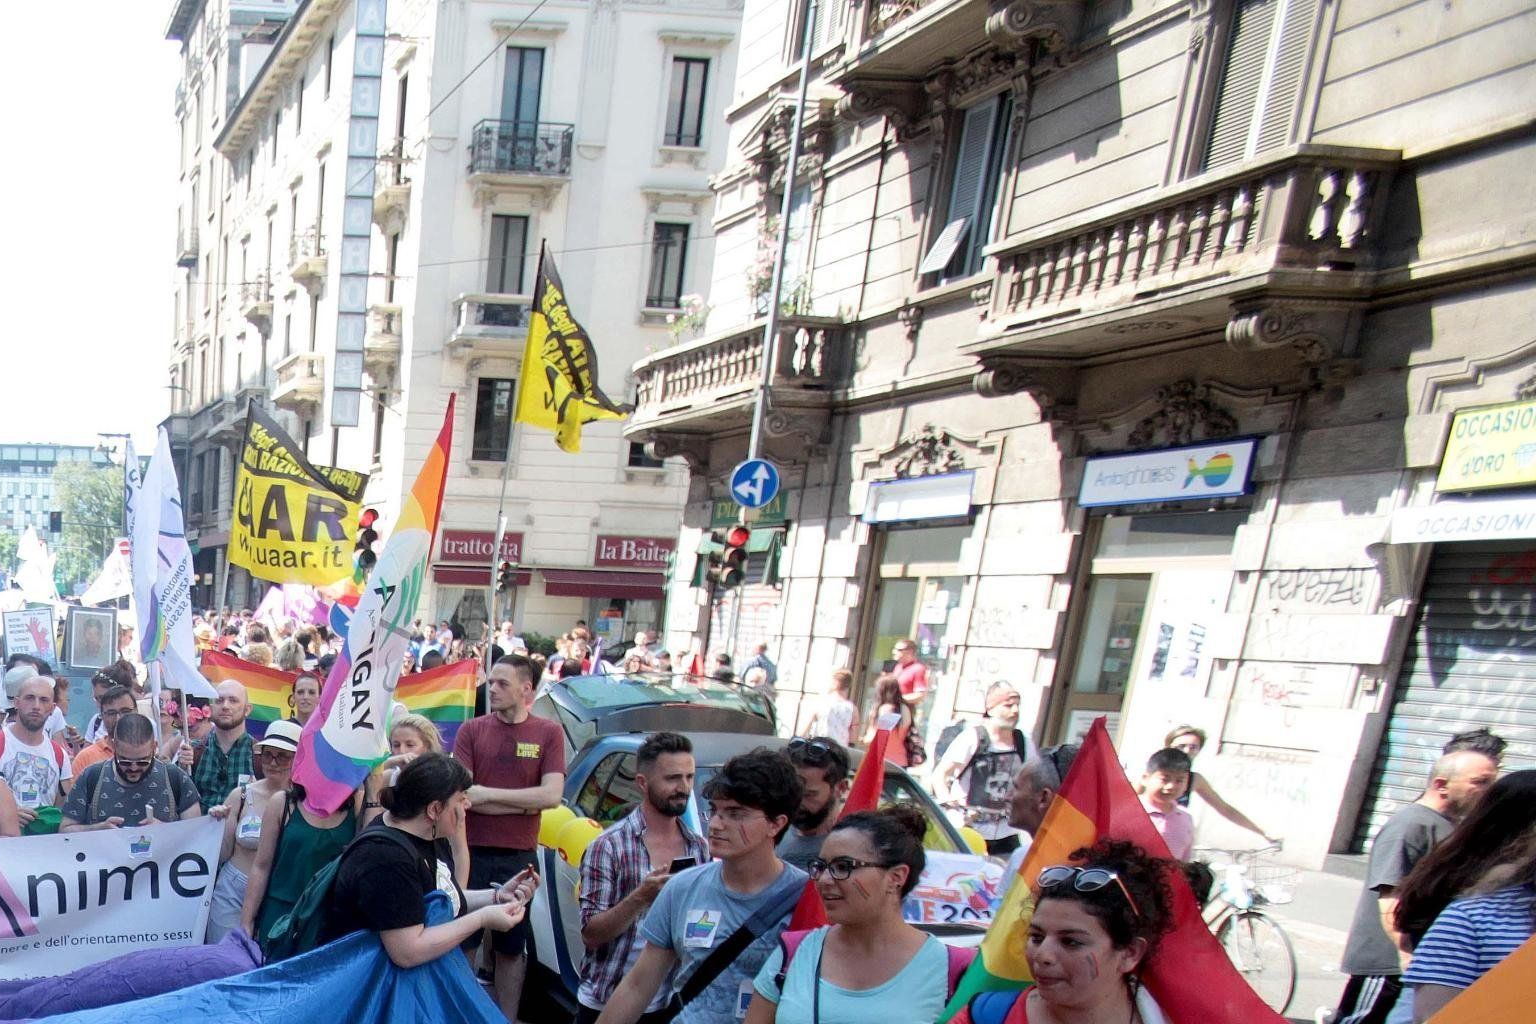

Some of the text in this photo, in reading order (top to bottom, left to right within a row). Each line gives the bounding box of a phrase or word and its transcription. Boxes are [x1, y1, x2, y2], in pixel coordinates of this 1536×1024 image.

[599, 538, 671, 562] la Baita
[45, 931, 159, 948] dell'orientamento
